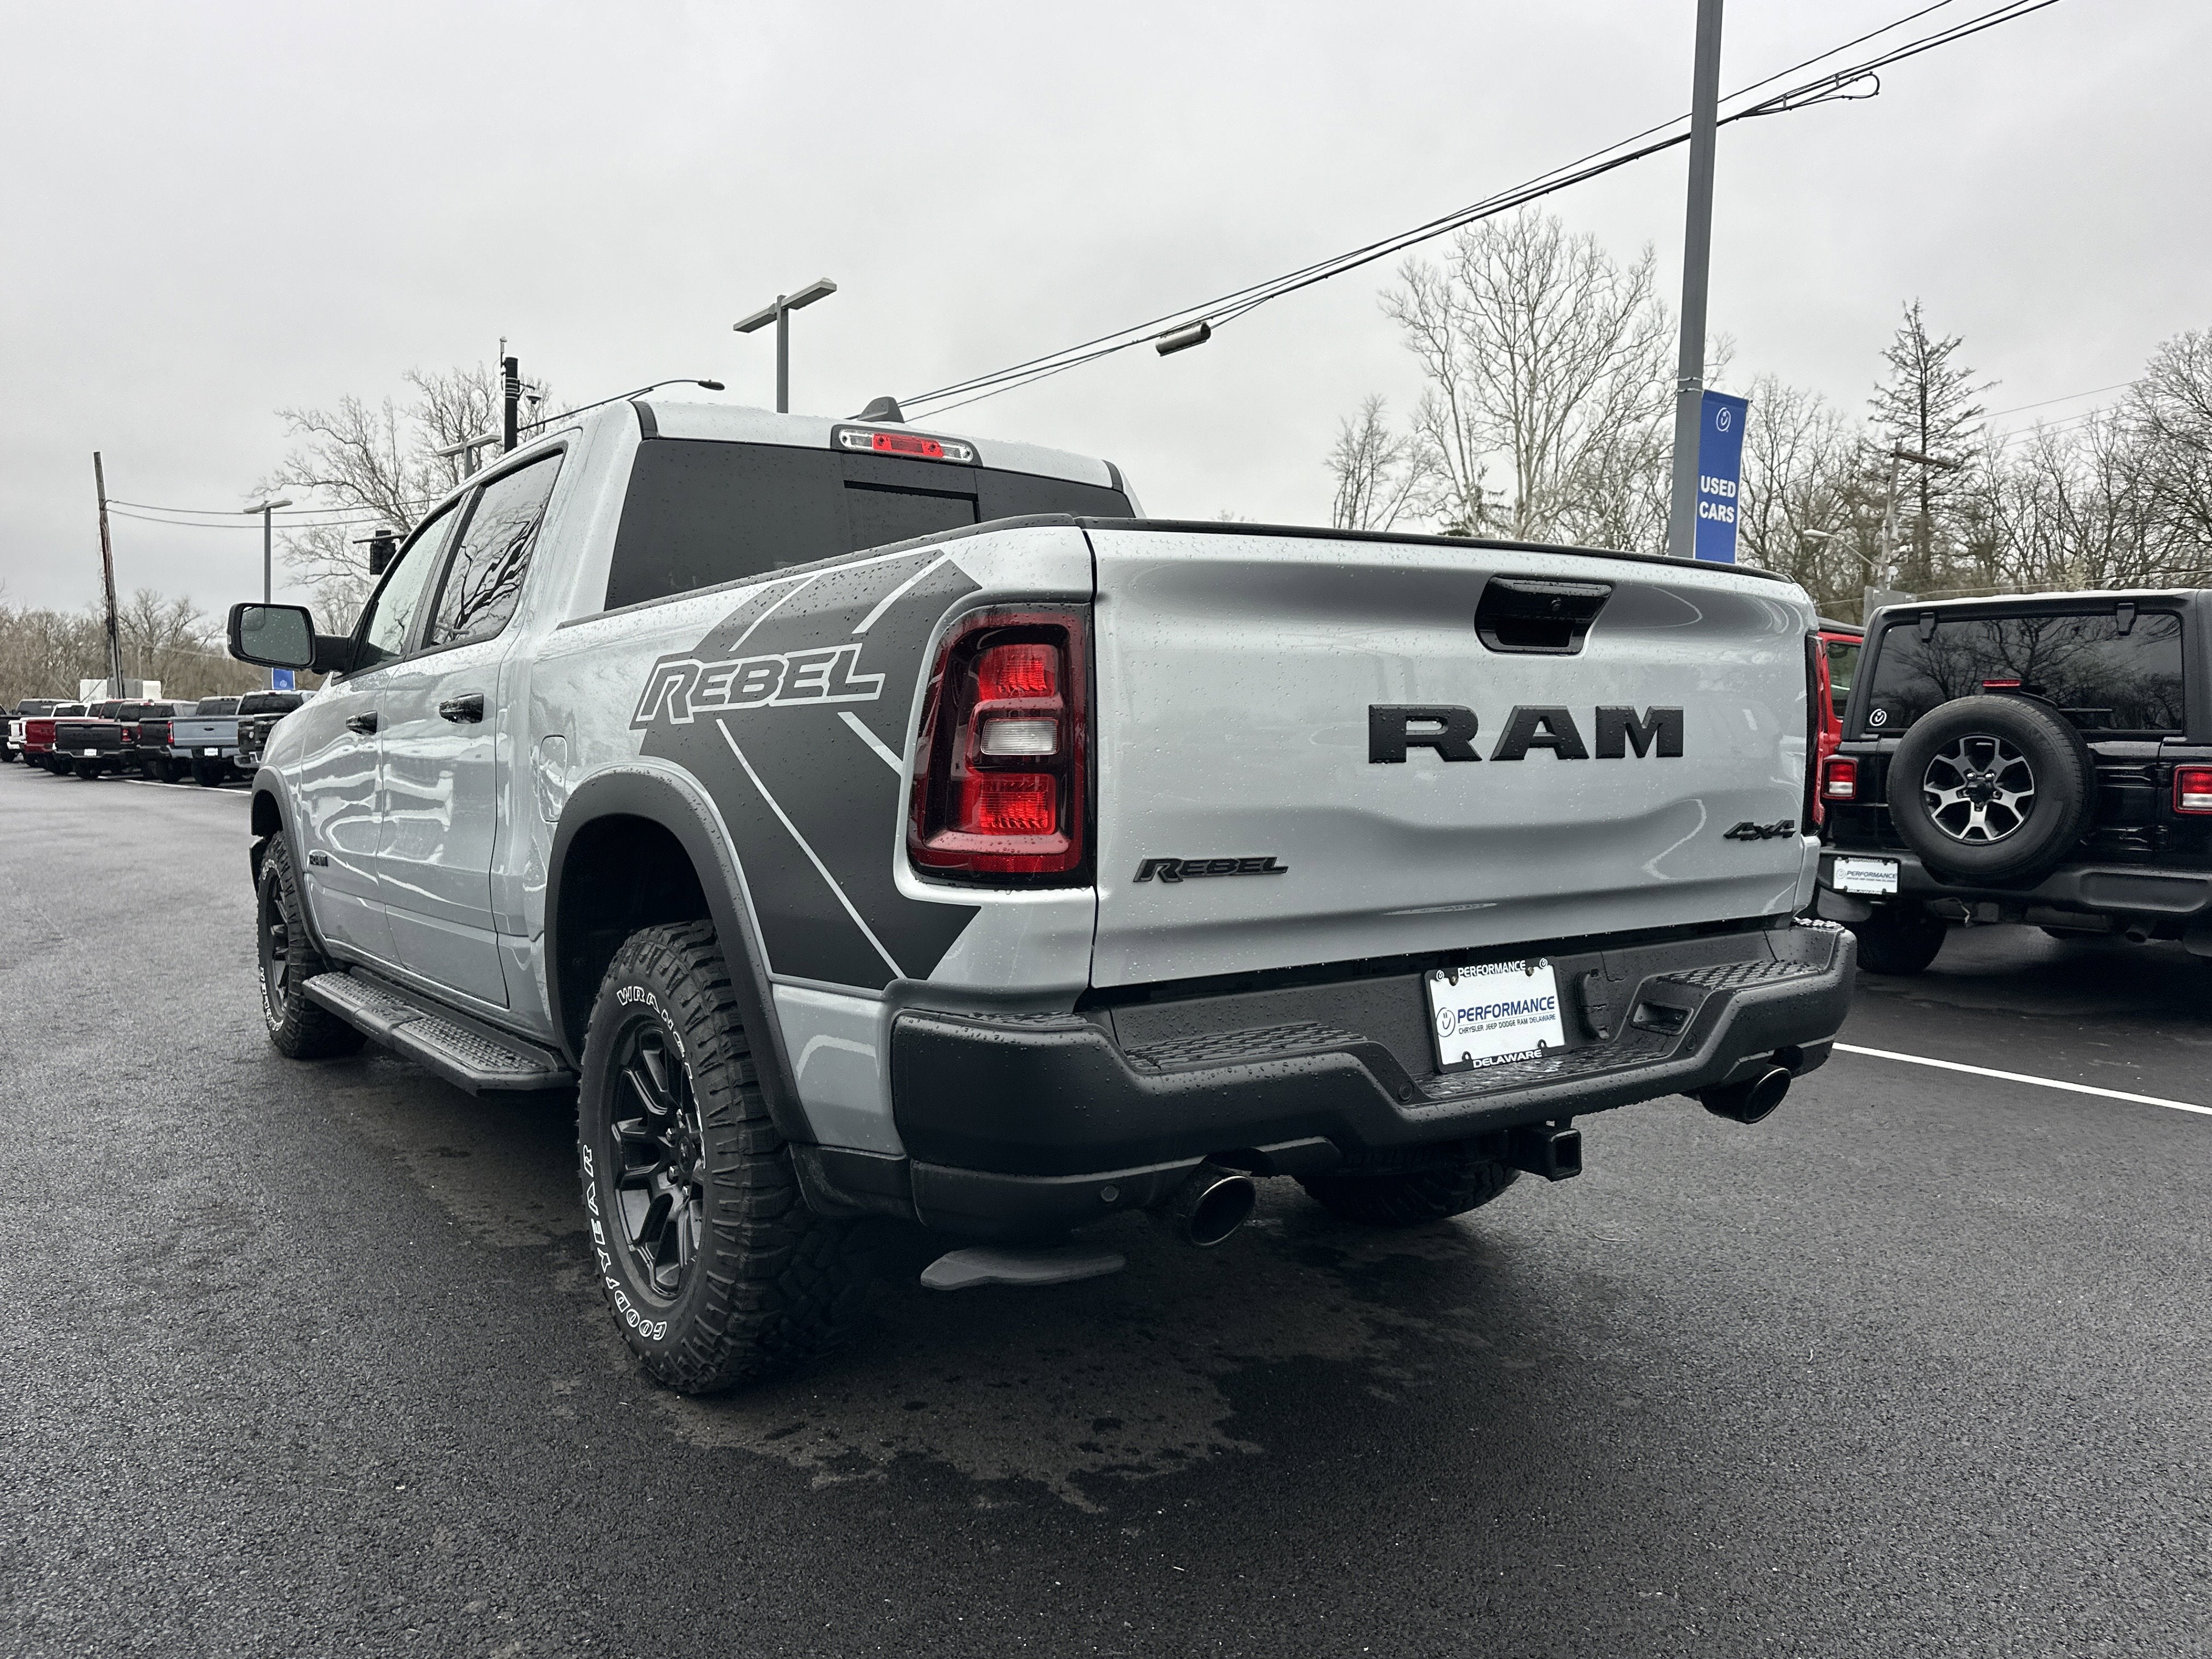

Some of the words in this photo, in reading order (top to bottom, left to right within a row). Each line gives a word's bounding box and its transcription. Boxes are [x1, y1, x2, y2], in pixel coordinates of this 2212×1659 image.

[1700, 475, 1736, 498] USED
[1699, 501, 1735, 523] CARS
[635, 642, 886, 724] REBEL
[1368, 704, 1684, 764] RAM
[1133, 856, 1289, 882] REBEL
[1847, 870, 1898, 879] PERFORMANCE
[1458, 960, 1526, 978] PERFORMANCE
[1458, 996, 1555, 1023] PERFORMANCE
[1459, 1025, 1483, 1034] CHRYSLER
[1499, 1020, 1516, 1029] DODGE
[1530, 1014, 1556, 1023] DELAWARE
[1472, 1049, 1542, 1068] DELAWARE
[584, 1144, 667, 1340] GOODYEAR
